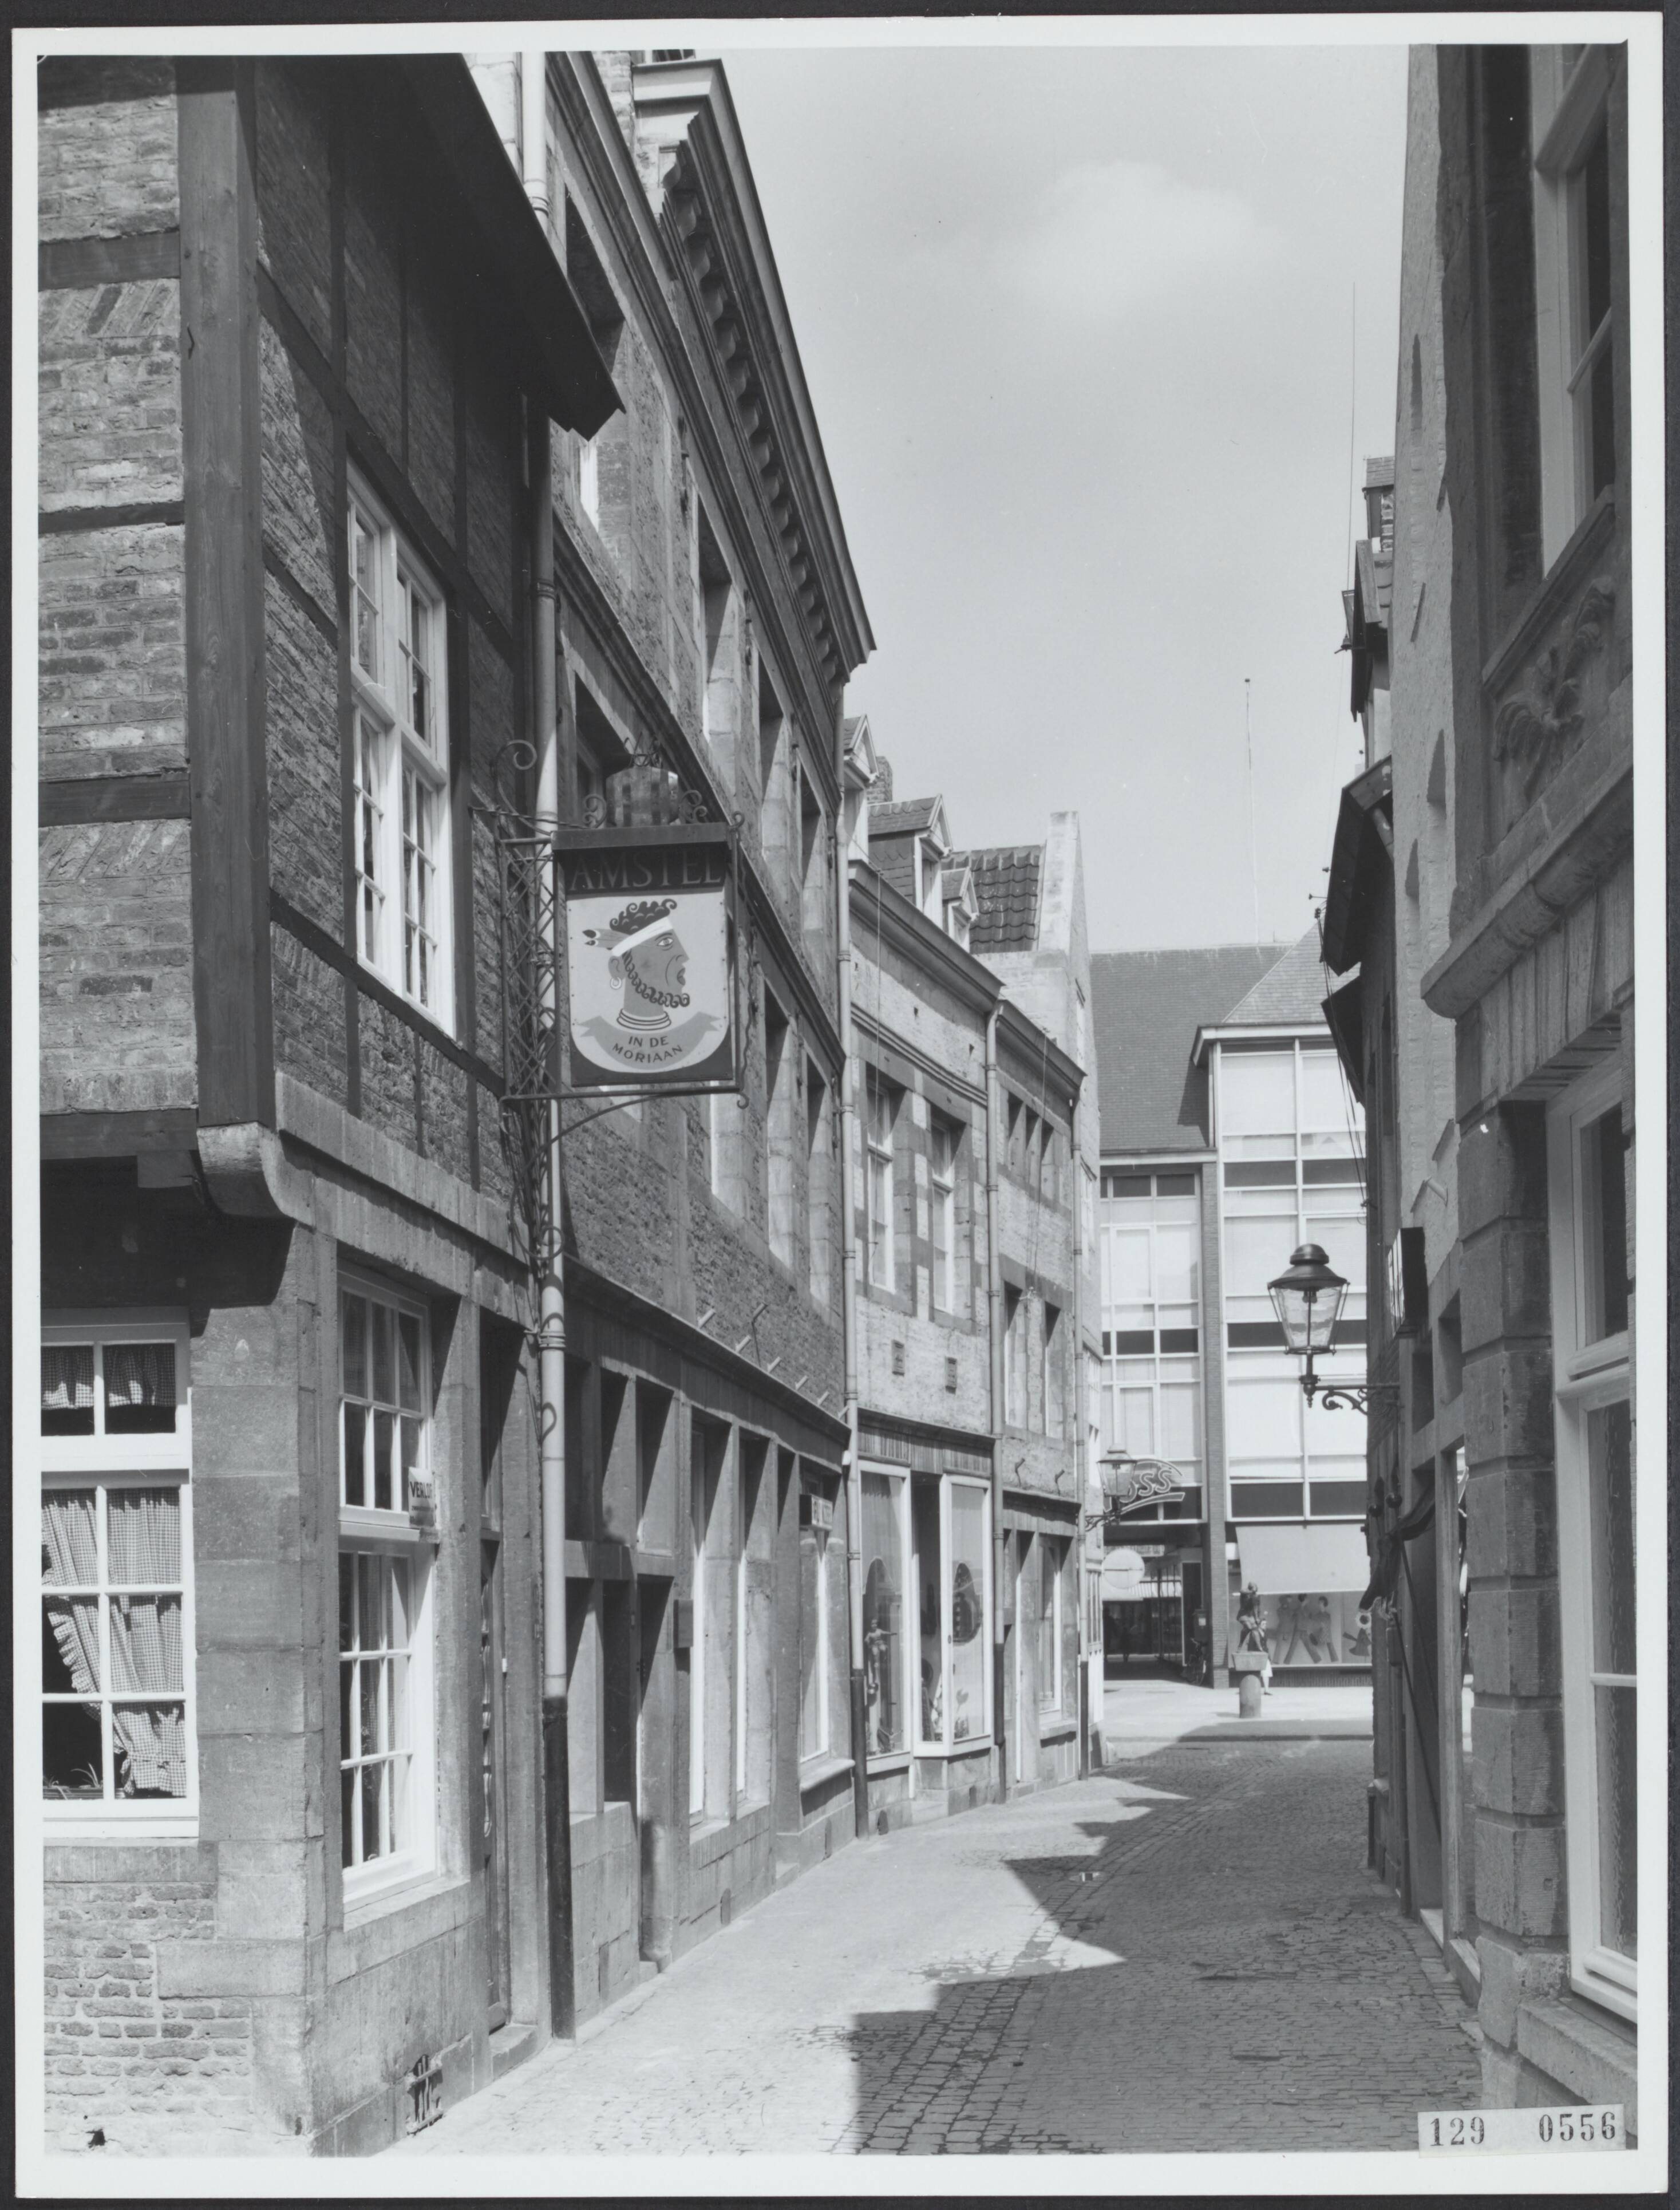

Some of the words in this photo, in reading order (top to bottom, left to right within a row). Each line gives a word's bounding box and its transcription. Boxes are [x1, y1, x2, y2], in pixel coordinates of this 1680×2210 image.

[569, 847, 721, 891] AMSTEL
[628, 1036, 643, 1047] IN
[650, 1036, 669, 1048] DE
[612, 1043, 683, 1063] MORIAAN
